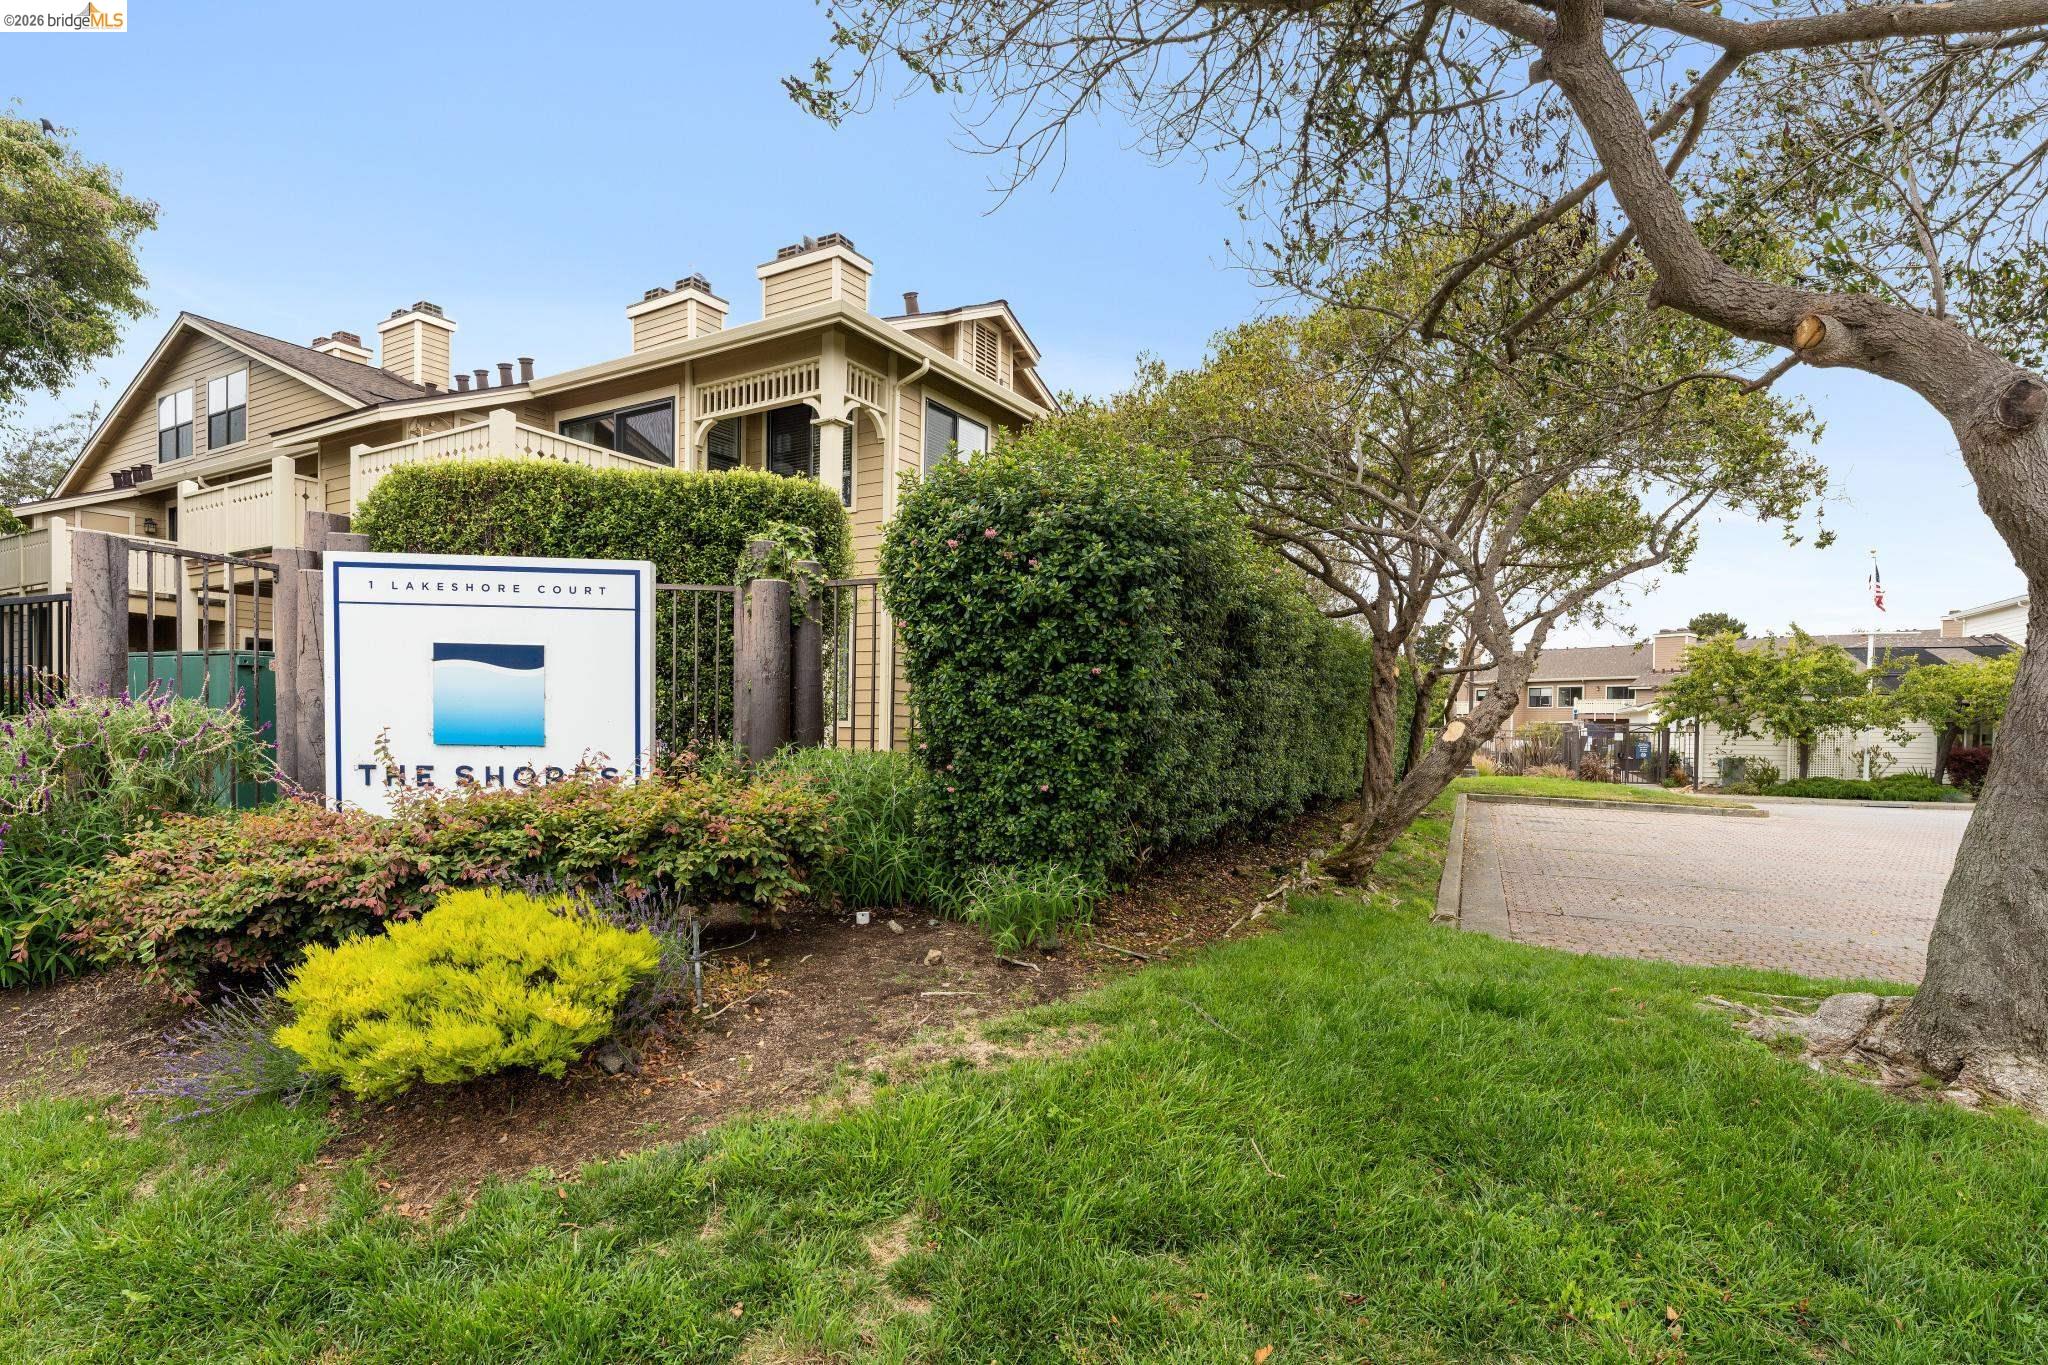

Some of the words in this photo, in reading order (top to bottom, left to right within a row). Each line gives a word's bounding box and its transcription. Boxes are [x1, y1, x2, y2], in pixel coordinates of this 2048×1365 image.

[368, 580, 373, 590] 1
[391, 580, 521, 593] LAKESHORE
[537, 585, 607, 595] COURT
[358, 764, 435, 787] THE
[455, 765, 619, 788] SHORS
